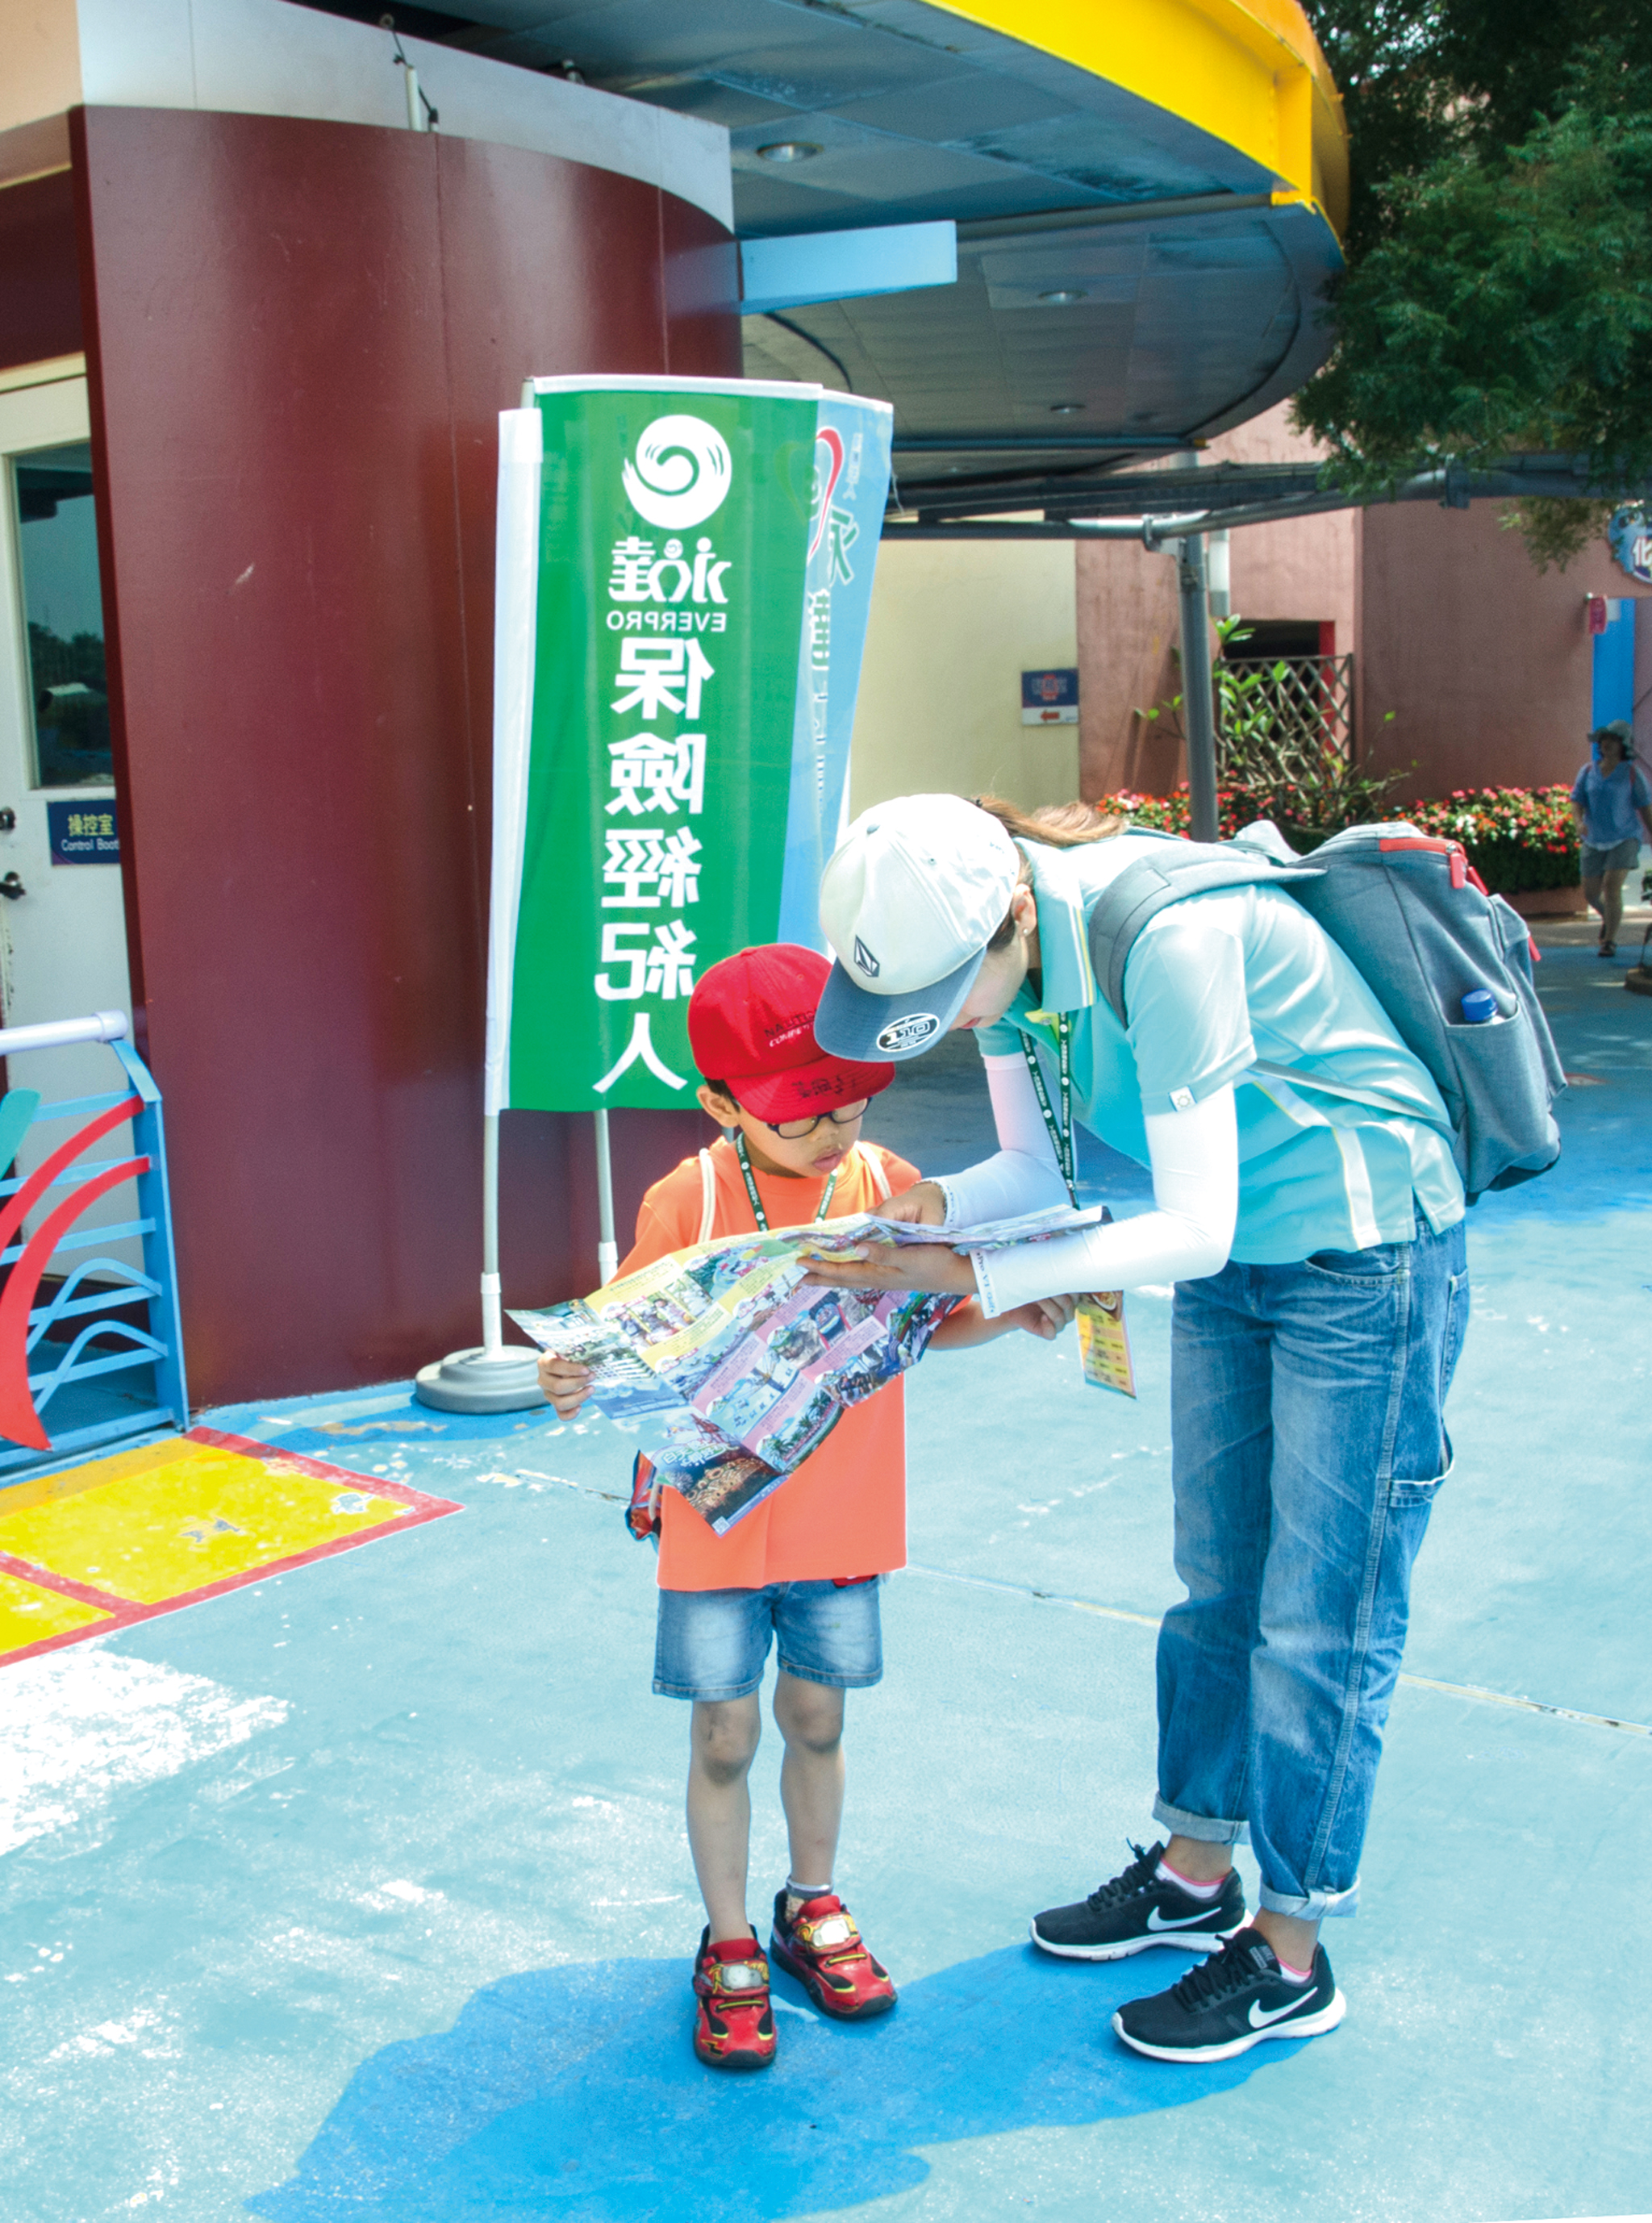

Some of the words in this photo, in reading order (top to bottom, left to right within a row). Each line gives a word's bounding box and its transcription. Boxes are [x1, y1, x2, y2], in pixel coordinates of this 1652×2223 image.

[61, 839, 94, 851] Control
[96, 837, 119, 850] Boot
[764, 1008, 818, 1038] NAUTIC
